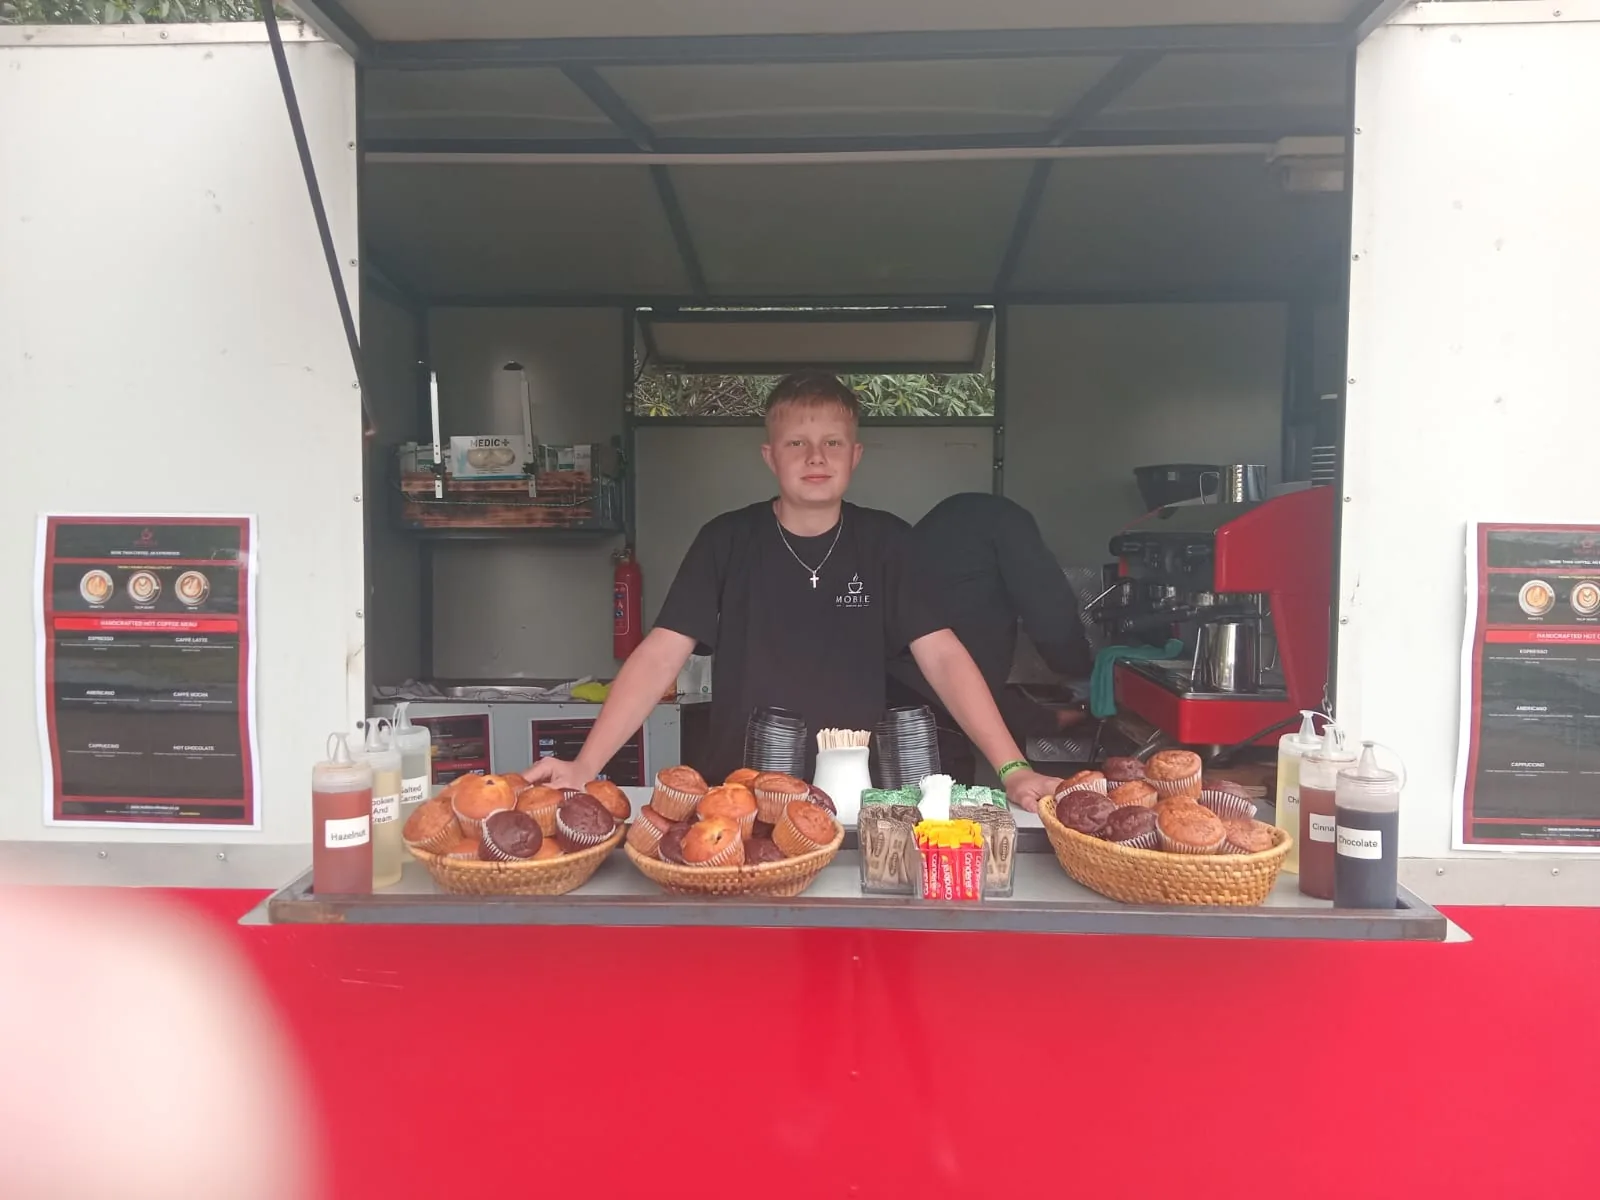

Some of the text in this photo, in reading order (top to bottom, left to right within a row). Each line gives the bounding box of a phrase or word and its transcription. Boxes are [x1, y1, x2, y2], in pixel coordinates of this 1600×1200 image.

[470, 438, 501, 448] MEDIC
[835, 595, 870, 604] MOBIE
[372, 797, 394, 806] ookies
[372, 815, 393, 823] ream
[1312, 822, 1336, 832] Cinna
[330, 828, 367, 841] Hazelnut
[1338, 834, 1379, 848] Chocolate
